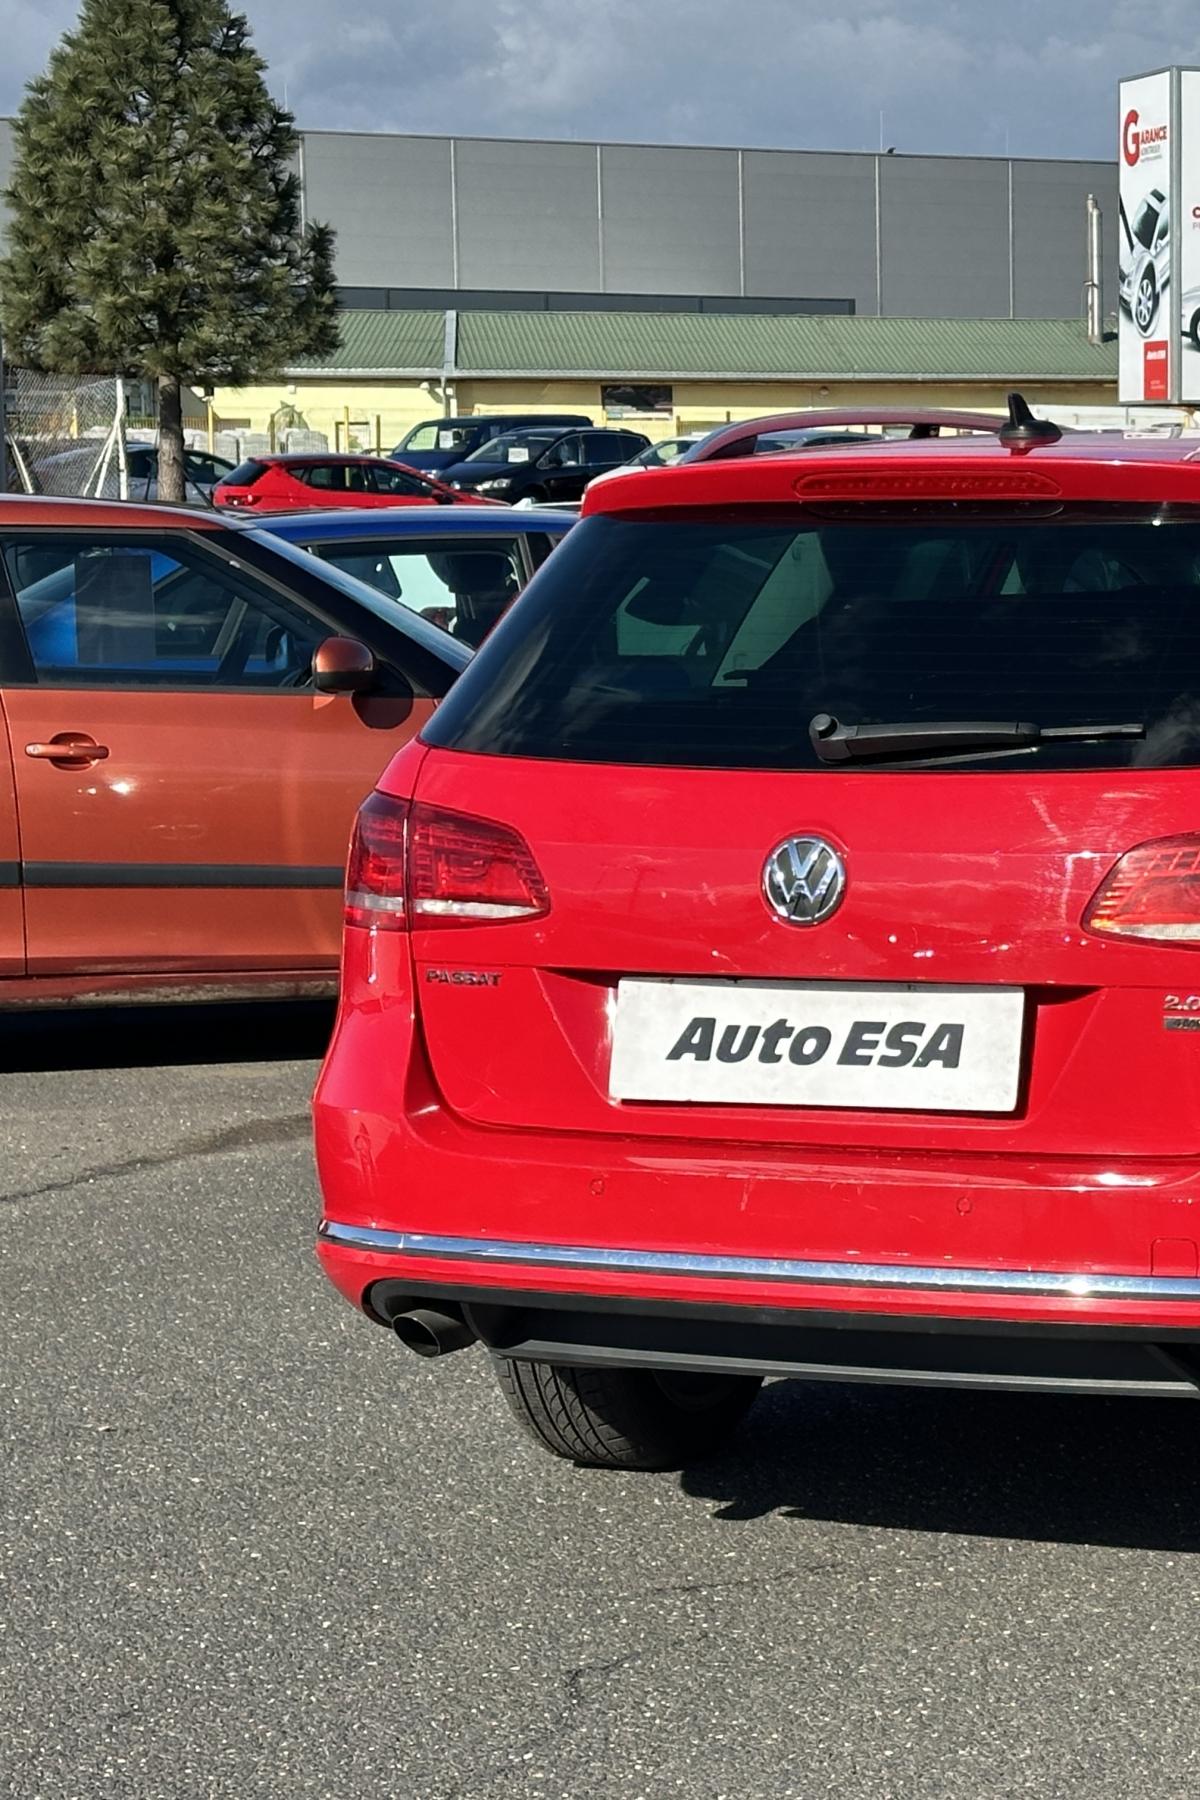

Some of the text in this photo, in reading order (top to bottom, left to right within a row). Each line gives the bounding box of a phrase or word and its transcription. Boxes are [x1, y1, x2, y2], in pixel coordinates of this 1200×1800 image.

[425, 967, 503, 987] PASSAT
[665, 1016, 965, 1069] Auto ESA
